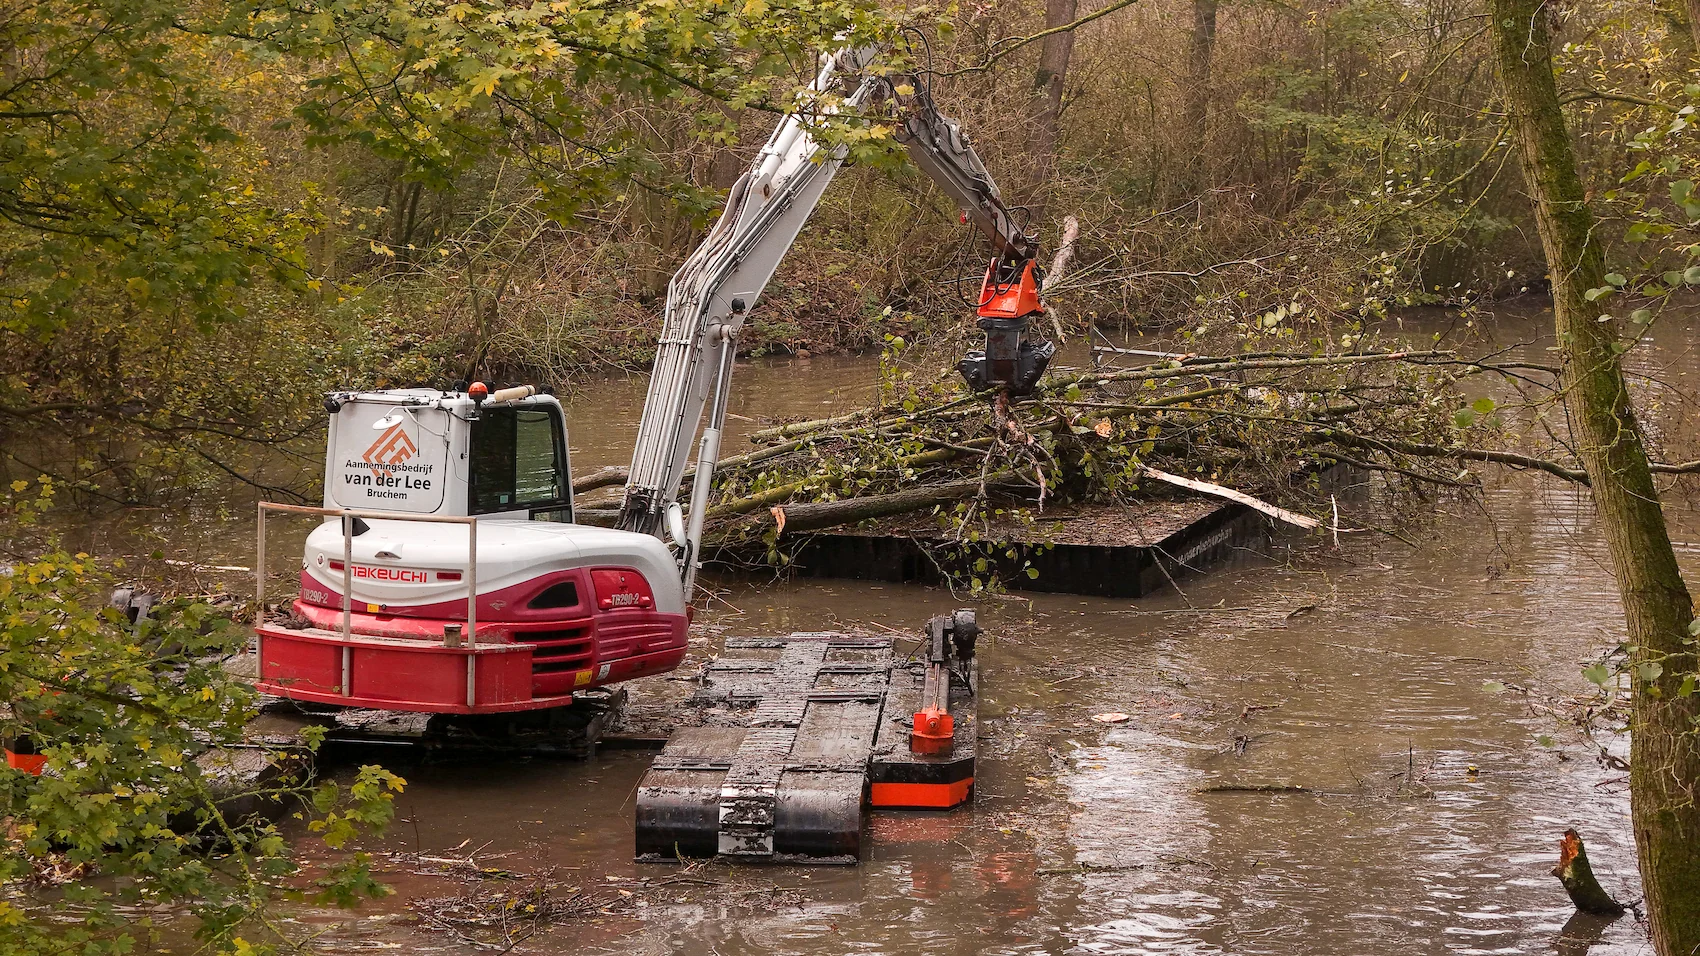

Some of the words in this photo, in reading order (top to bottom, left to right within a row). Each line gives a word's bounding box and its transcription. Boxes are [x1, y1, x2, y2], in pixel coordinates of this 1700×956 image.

[345, 459, 433, 475] Aannemingsbedrijf
[345, 474, 371, 486] van
[375, 472, 401, 488] der
[405, 475, 431, 490] Lee
[367, 488, 408, 500] Bruchem
